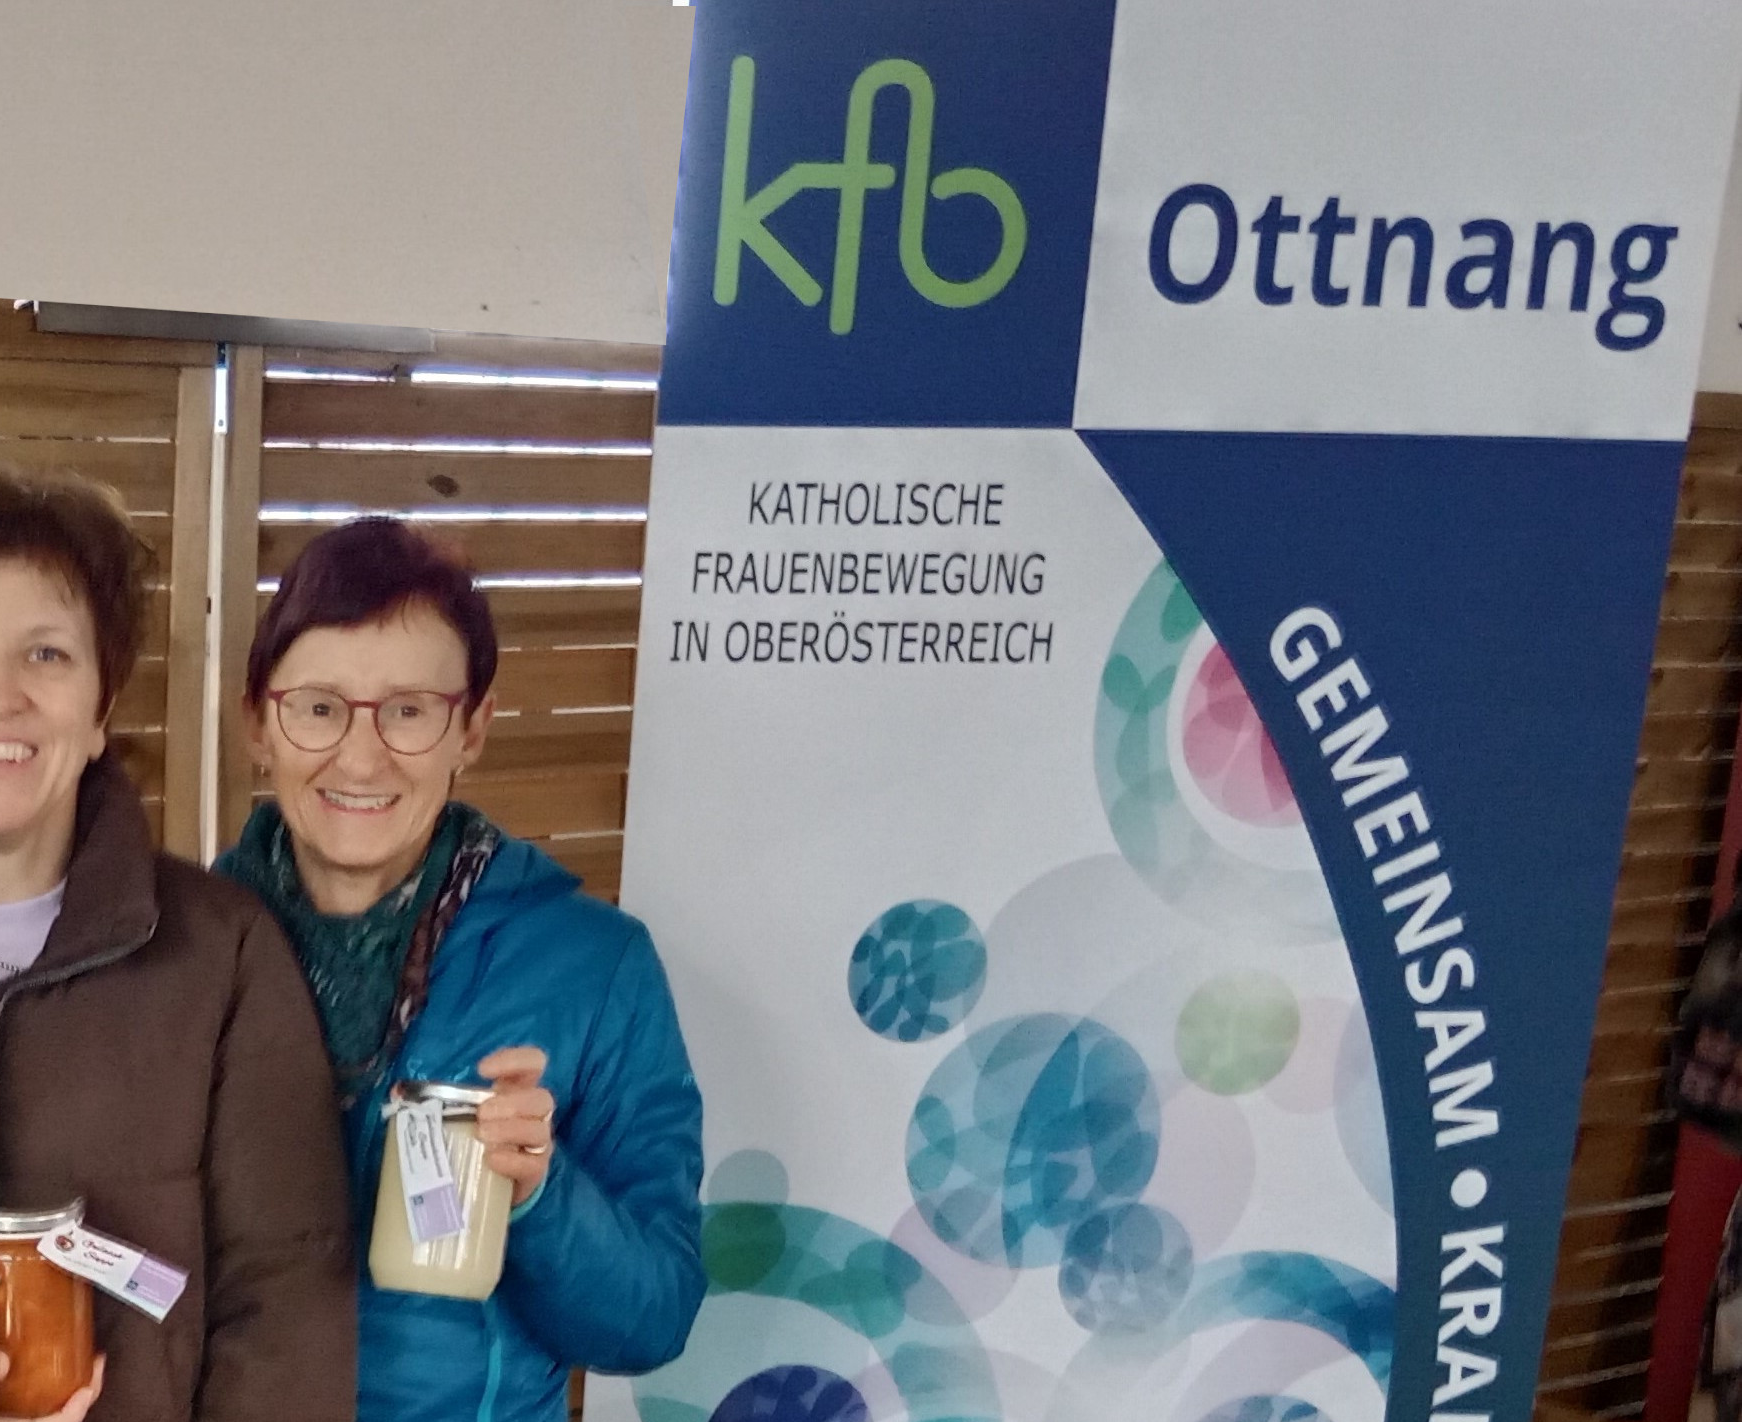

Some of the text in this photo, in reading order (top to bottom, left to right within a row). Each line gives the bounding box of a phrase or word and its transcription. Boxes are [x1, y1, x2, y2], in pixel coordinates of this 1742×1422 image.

[713, 55, 1027, 335] kfb
[1148, 183, 1678, 352] Ottnang
[747, 481, 1005, 527] KATHOLISCHE
[691, 551, 1046, 597] FRAUENBEWEGUNG
[668, 611, 1054, 665] IN OBERÖSTERREICH
[1269, 606, 1501, 1149] GEMEINSAM
